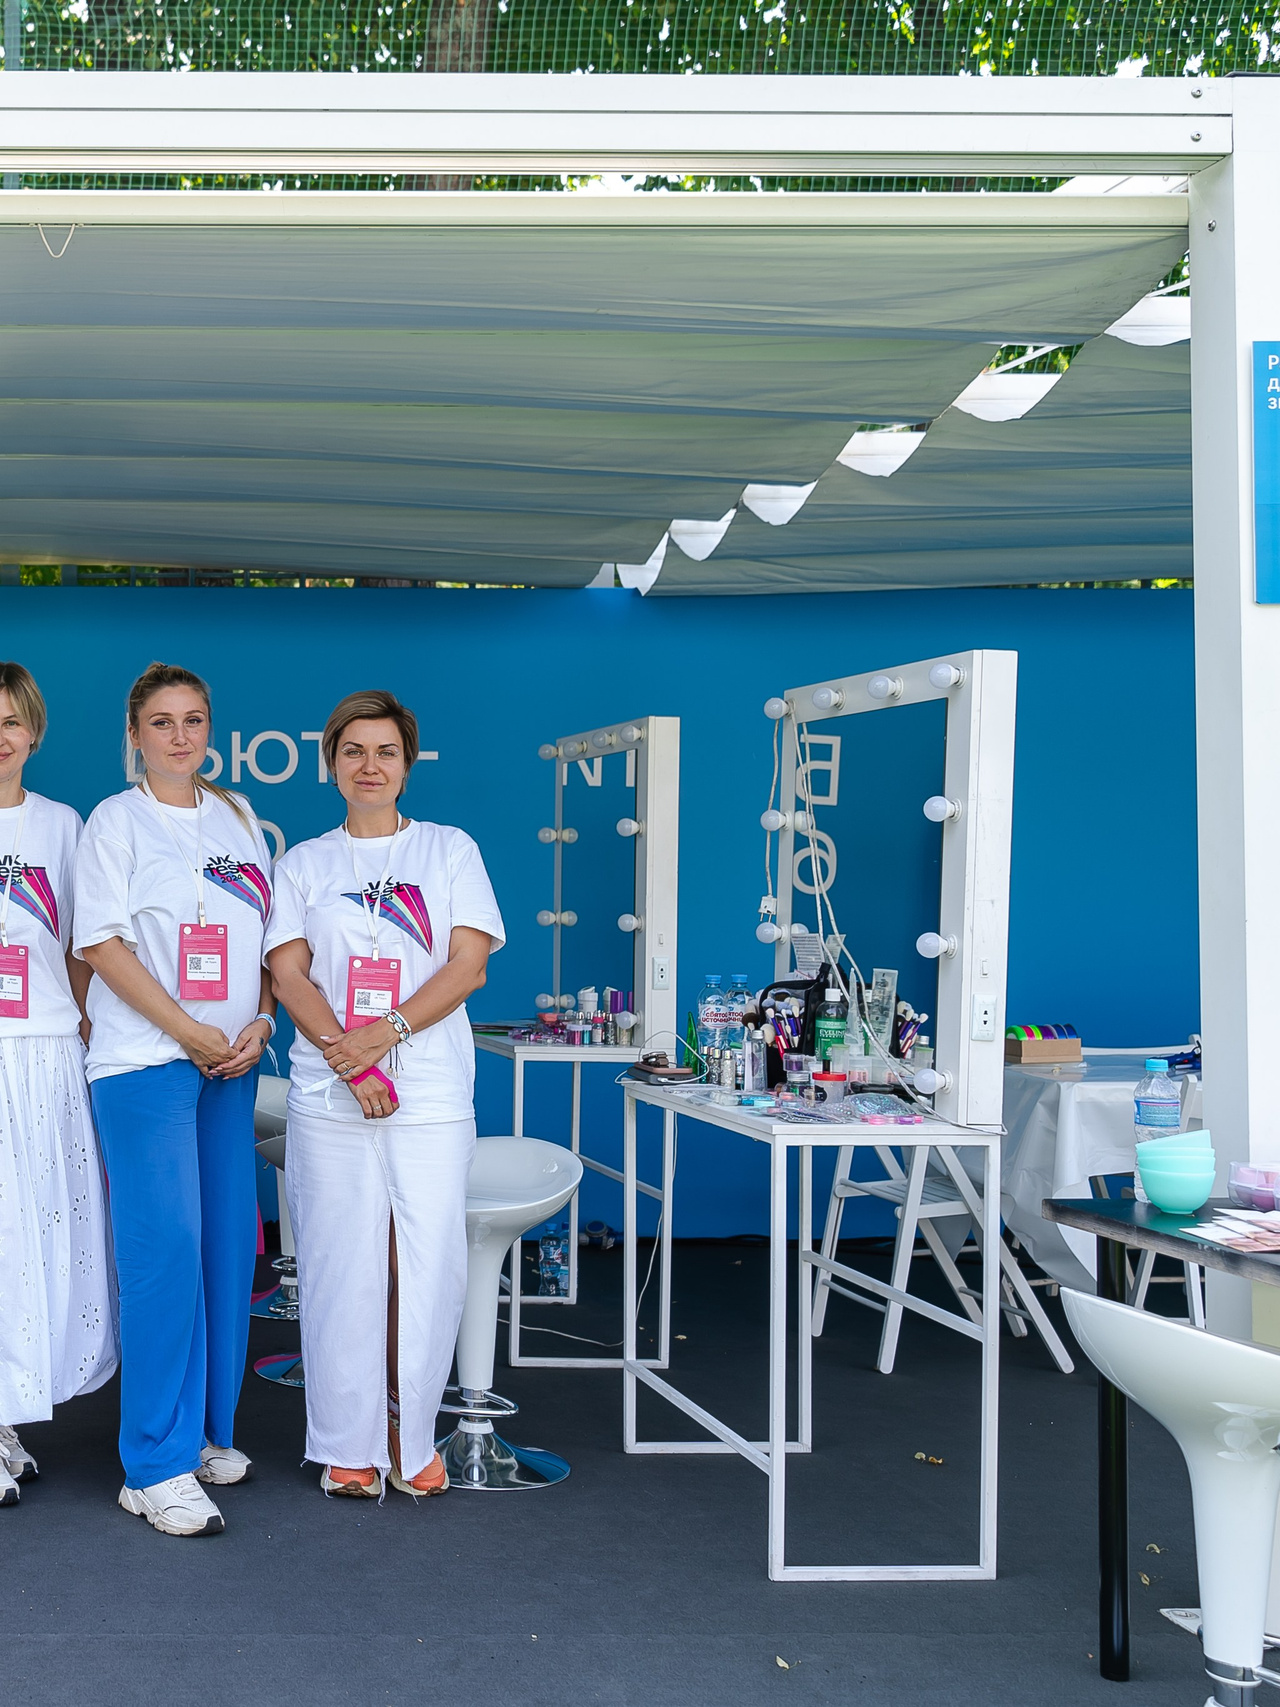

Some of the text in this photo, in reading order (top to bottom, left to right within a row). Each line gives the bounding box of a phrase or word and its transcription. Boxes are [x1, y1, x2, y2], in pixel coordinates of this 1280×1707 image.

[208, 853, 236, 866] VK
[206, 860, 250, 877] fest
[220, 873, 244, 884] 2024
